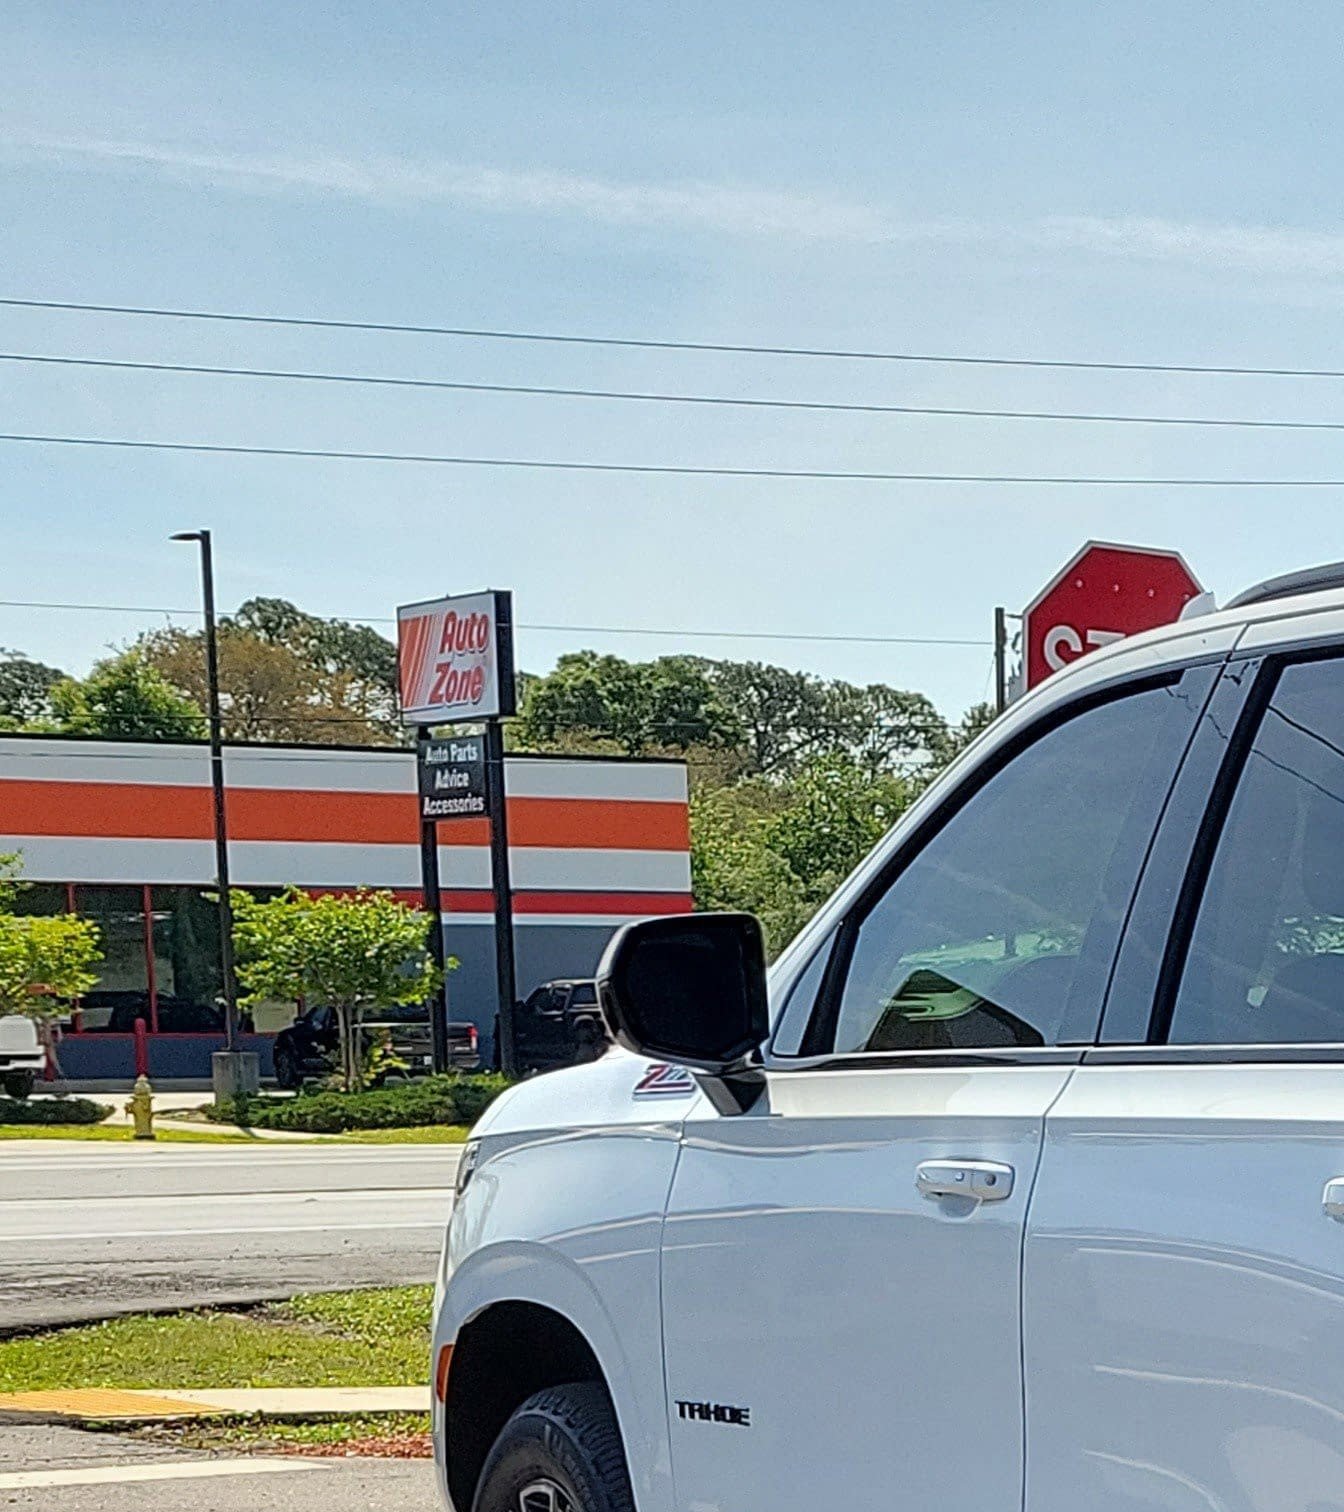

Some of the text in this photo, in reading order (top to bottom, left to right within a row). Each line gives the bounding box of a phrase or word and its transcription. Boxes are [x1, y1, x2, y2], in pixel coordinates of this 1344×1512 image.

[439, 611, 489, 656] Auto
[428, 661, 485, 705] Zone
[426, 744, 478, 763] Auto Parts
[435, 769, 470, 789] Advice
[423, 792, 484, 816] Accessories
[674, 1400, 751, 1427] TAHOE
